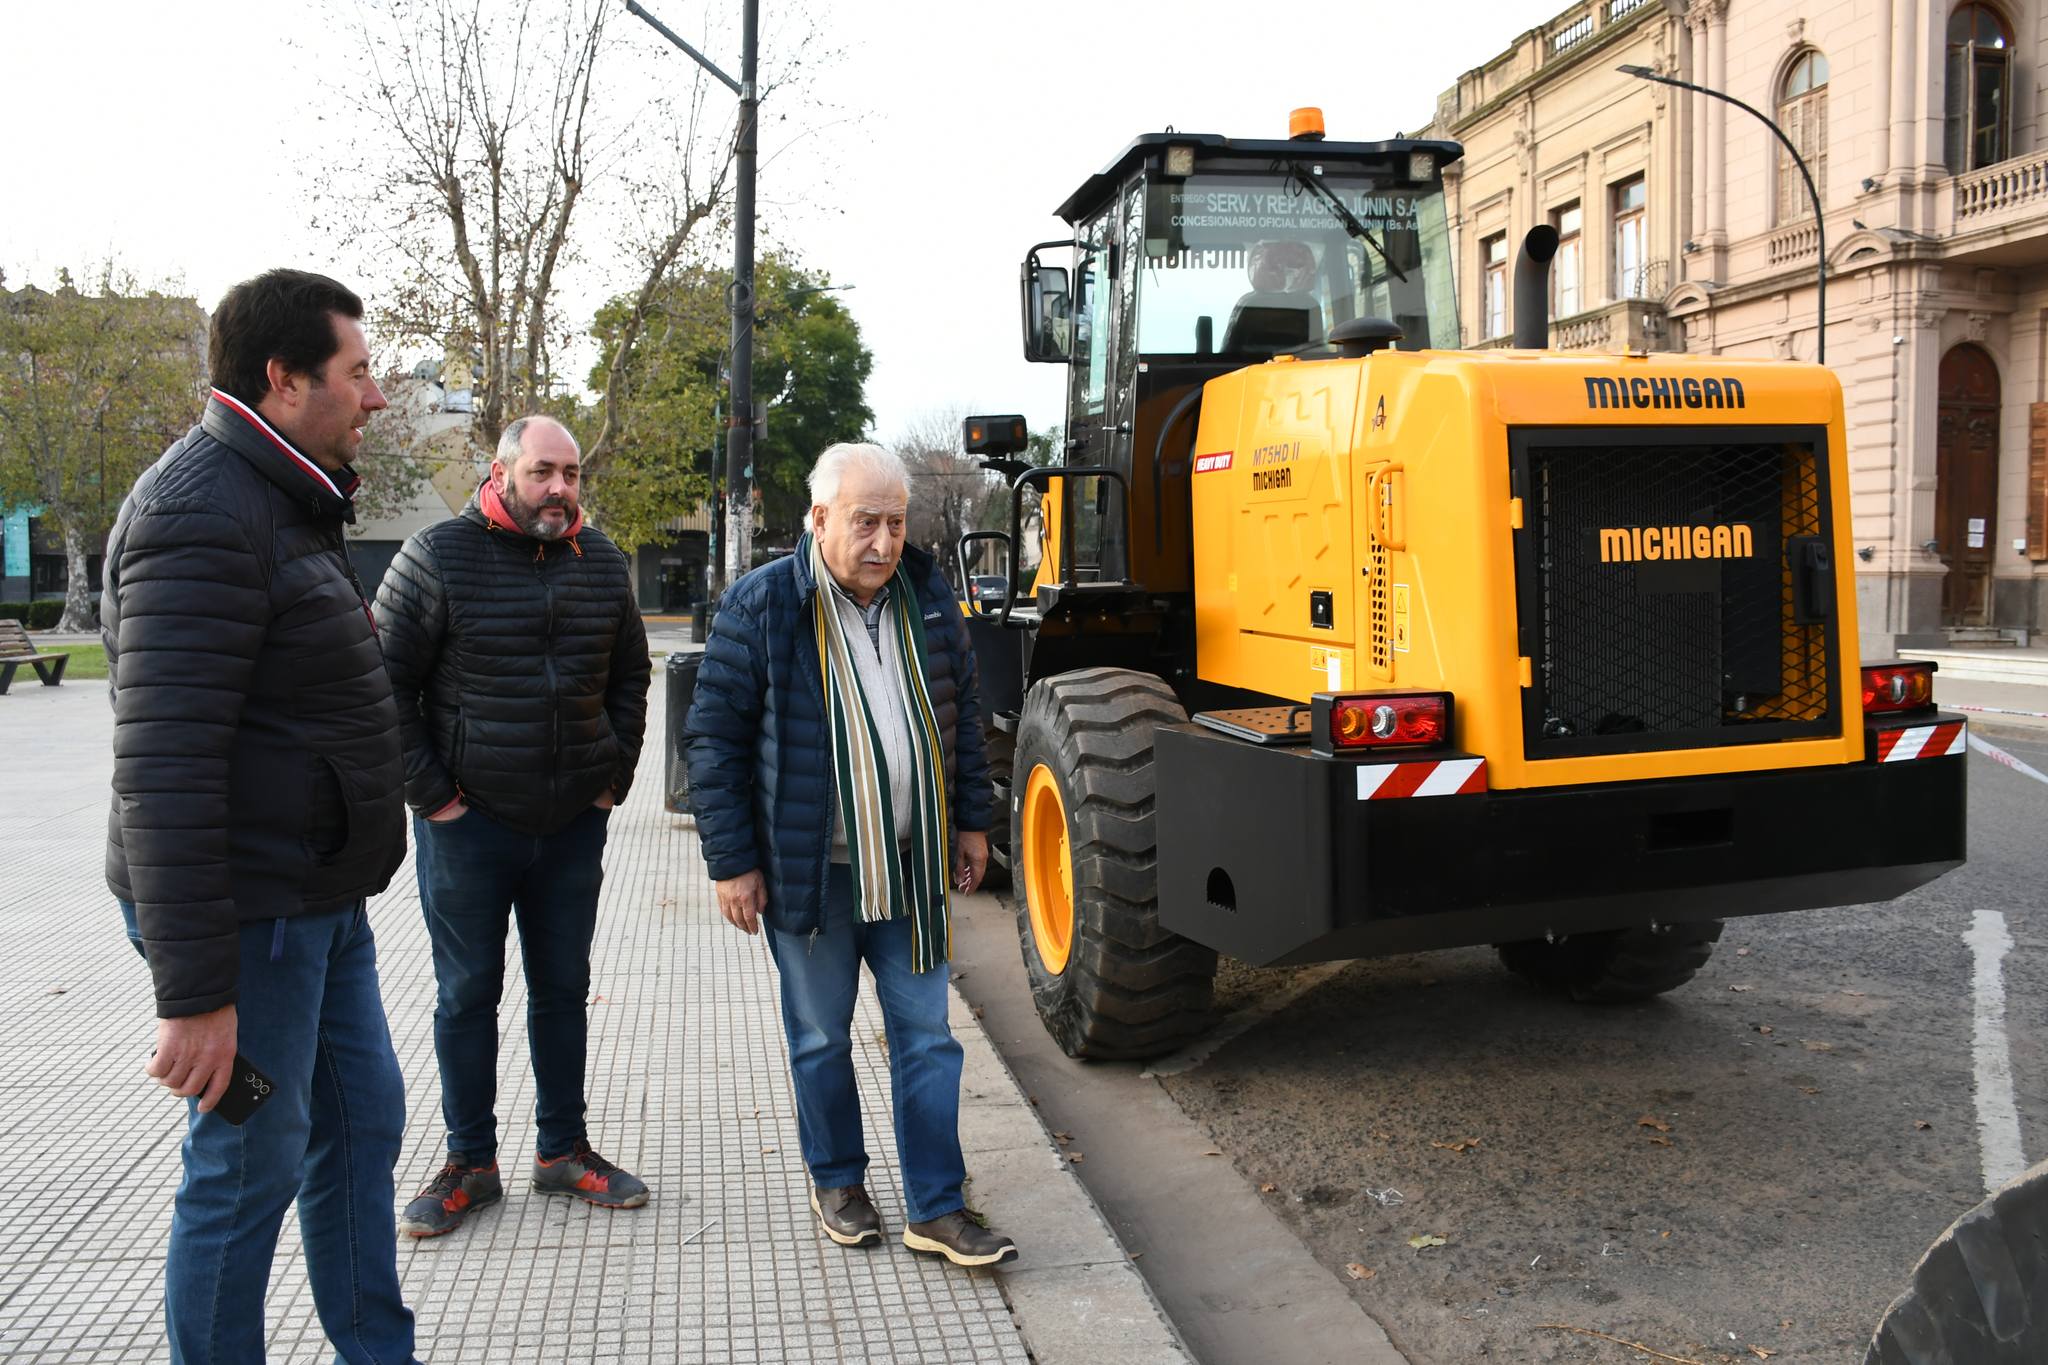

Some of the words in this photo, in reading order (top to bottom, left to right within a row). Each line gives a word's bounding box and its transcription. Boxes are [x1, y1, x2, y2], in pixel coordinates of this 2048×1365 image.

[1207, 193, 1250, 213] SERV.
[1254, 195, 1264, 213] Y
[1267, 195, 1300, 215] REP.
[1350, 197, 1392, 216] JUNIN
[1171, 215, 1257, 228] CONCESIONARIO
[1260, 217, 1297, 229] OFICIAL
[1584, 377, 1745, 409] MICHIGAN
[1196, 457, 1216, 472] HEAVY
[1214, 454, 1232, 469] DUTY
[1253, 443, 1289, 466] M75HD
[1253, 468, 1291, 492] MICHIGAN
[1600, 524, 1752, 562] MICHIGAN
